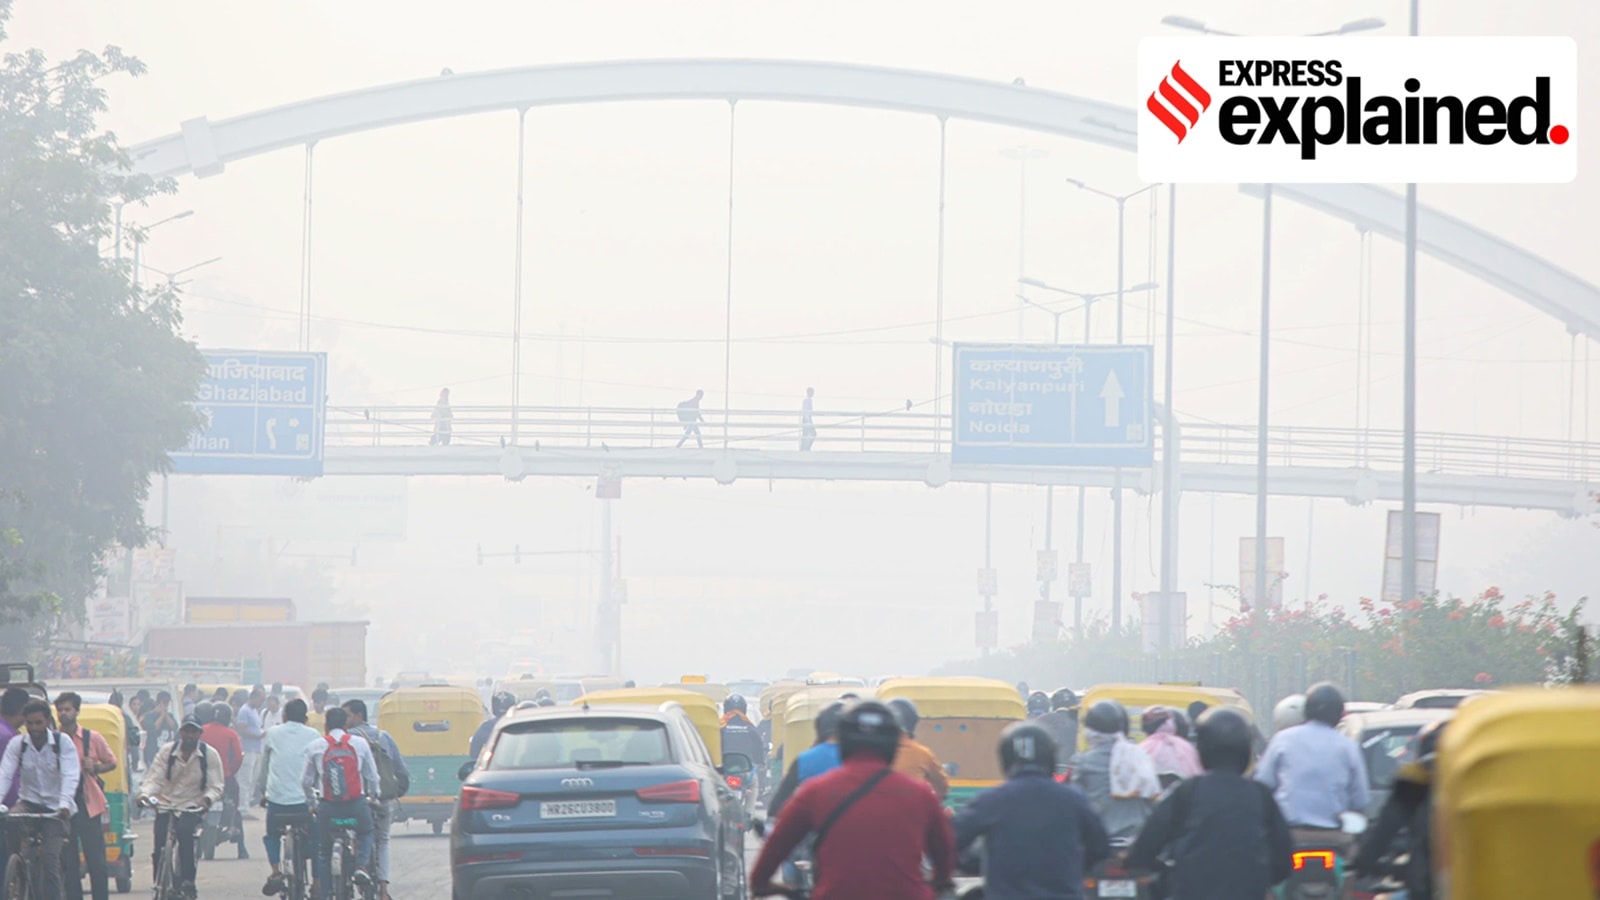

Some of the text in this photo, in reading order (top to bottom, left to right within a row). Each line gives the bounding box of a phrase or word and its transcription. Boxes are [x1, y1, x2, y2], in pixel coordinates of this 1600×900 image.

[198, 384, 306, 402] Ghaziabad
[969, 378, 1085, 395] Kalyanpuri
[969, 420, 1030, 434] Noida
